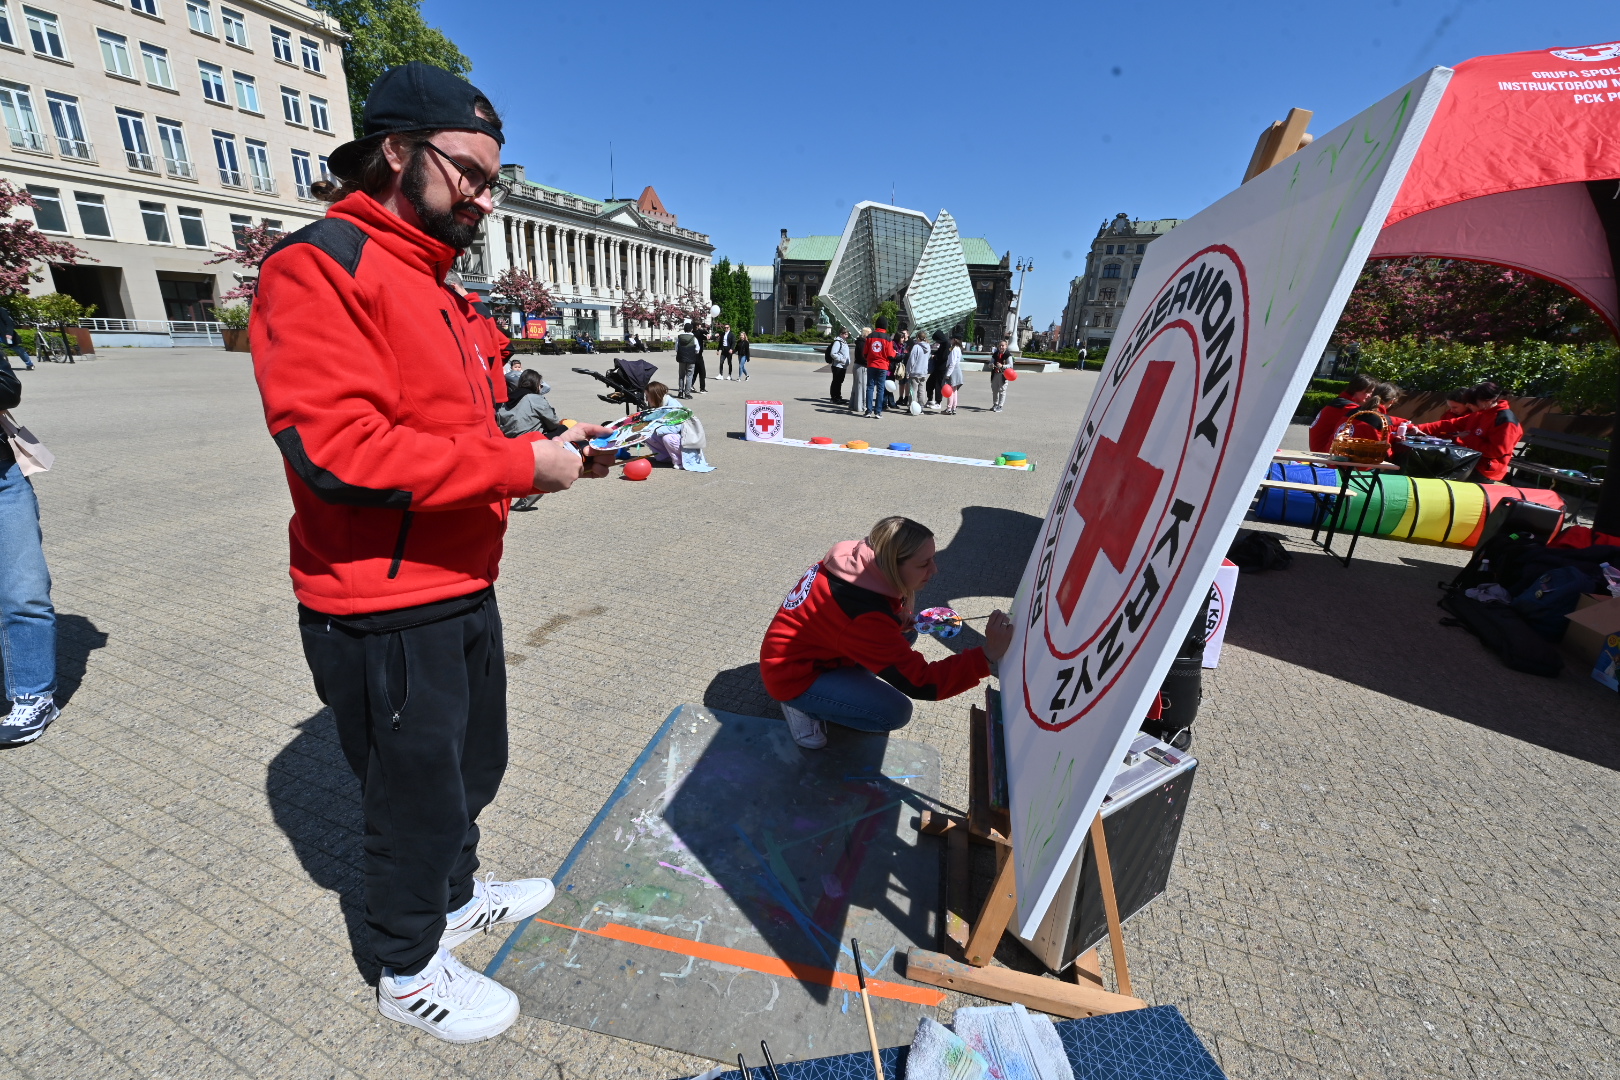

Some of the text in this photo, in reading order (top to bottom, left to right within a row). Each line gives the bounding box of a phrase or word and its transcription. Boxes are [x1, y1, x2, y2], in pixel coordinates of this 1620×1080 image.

[1498, 79, 1608, 91] INSTRUKTORÓW
[1531, 67, 1620, 79] GRUPA SPOŁ
[1573, 92, 1620, 104] PCK P
[1112, 262, 1235, 449] CZERWONY
[1030, 420, 1095, 630] POLSKI
[1049, 498, 1196, 724] KRZYŻ
